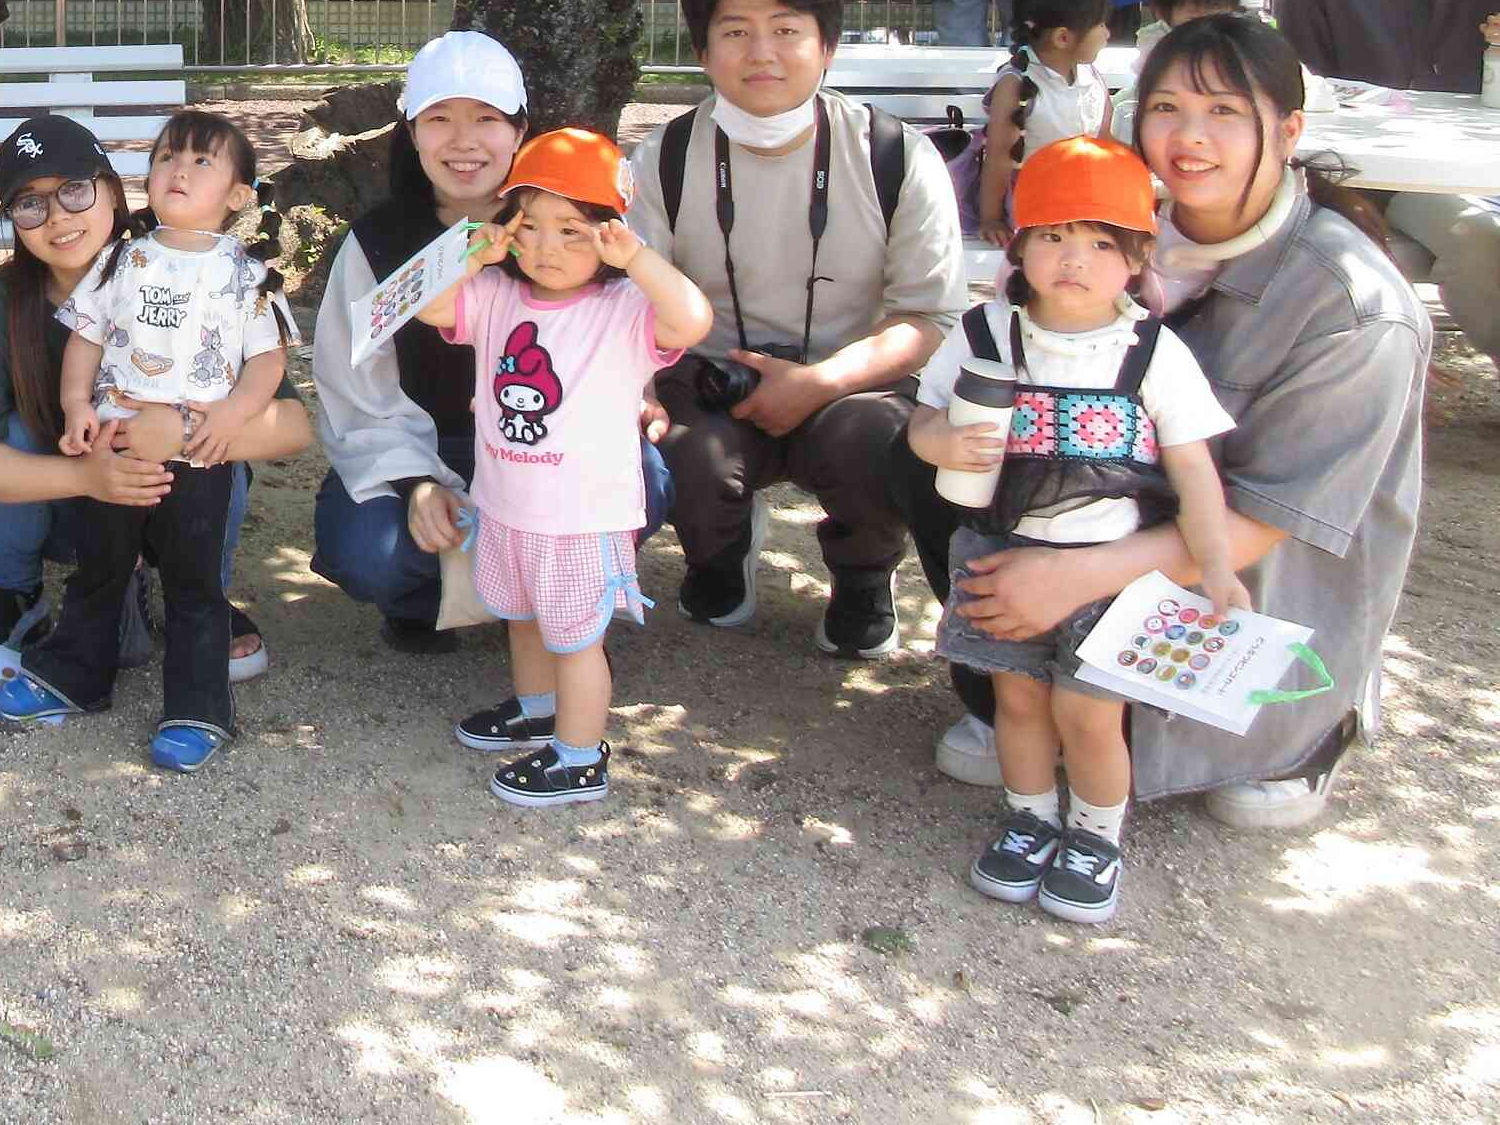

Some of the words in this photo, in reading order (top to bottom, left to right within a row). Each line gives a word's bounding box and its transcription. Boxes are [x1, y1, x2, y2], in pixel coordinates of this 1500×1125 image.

[139, 285, 172, 306] TOM
[137, 305, 187, 328] JERRY
[500, 447, 564, 466] Melody
